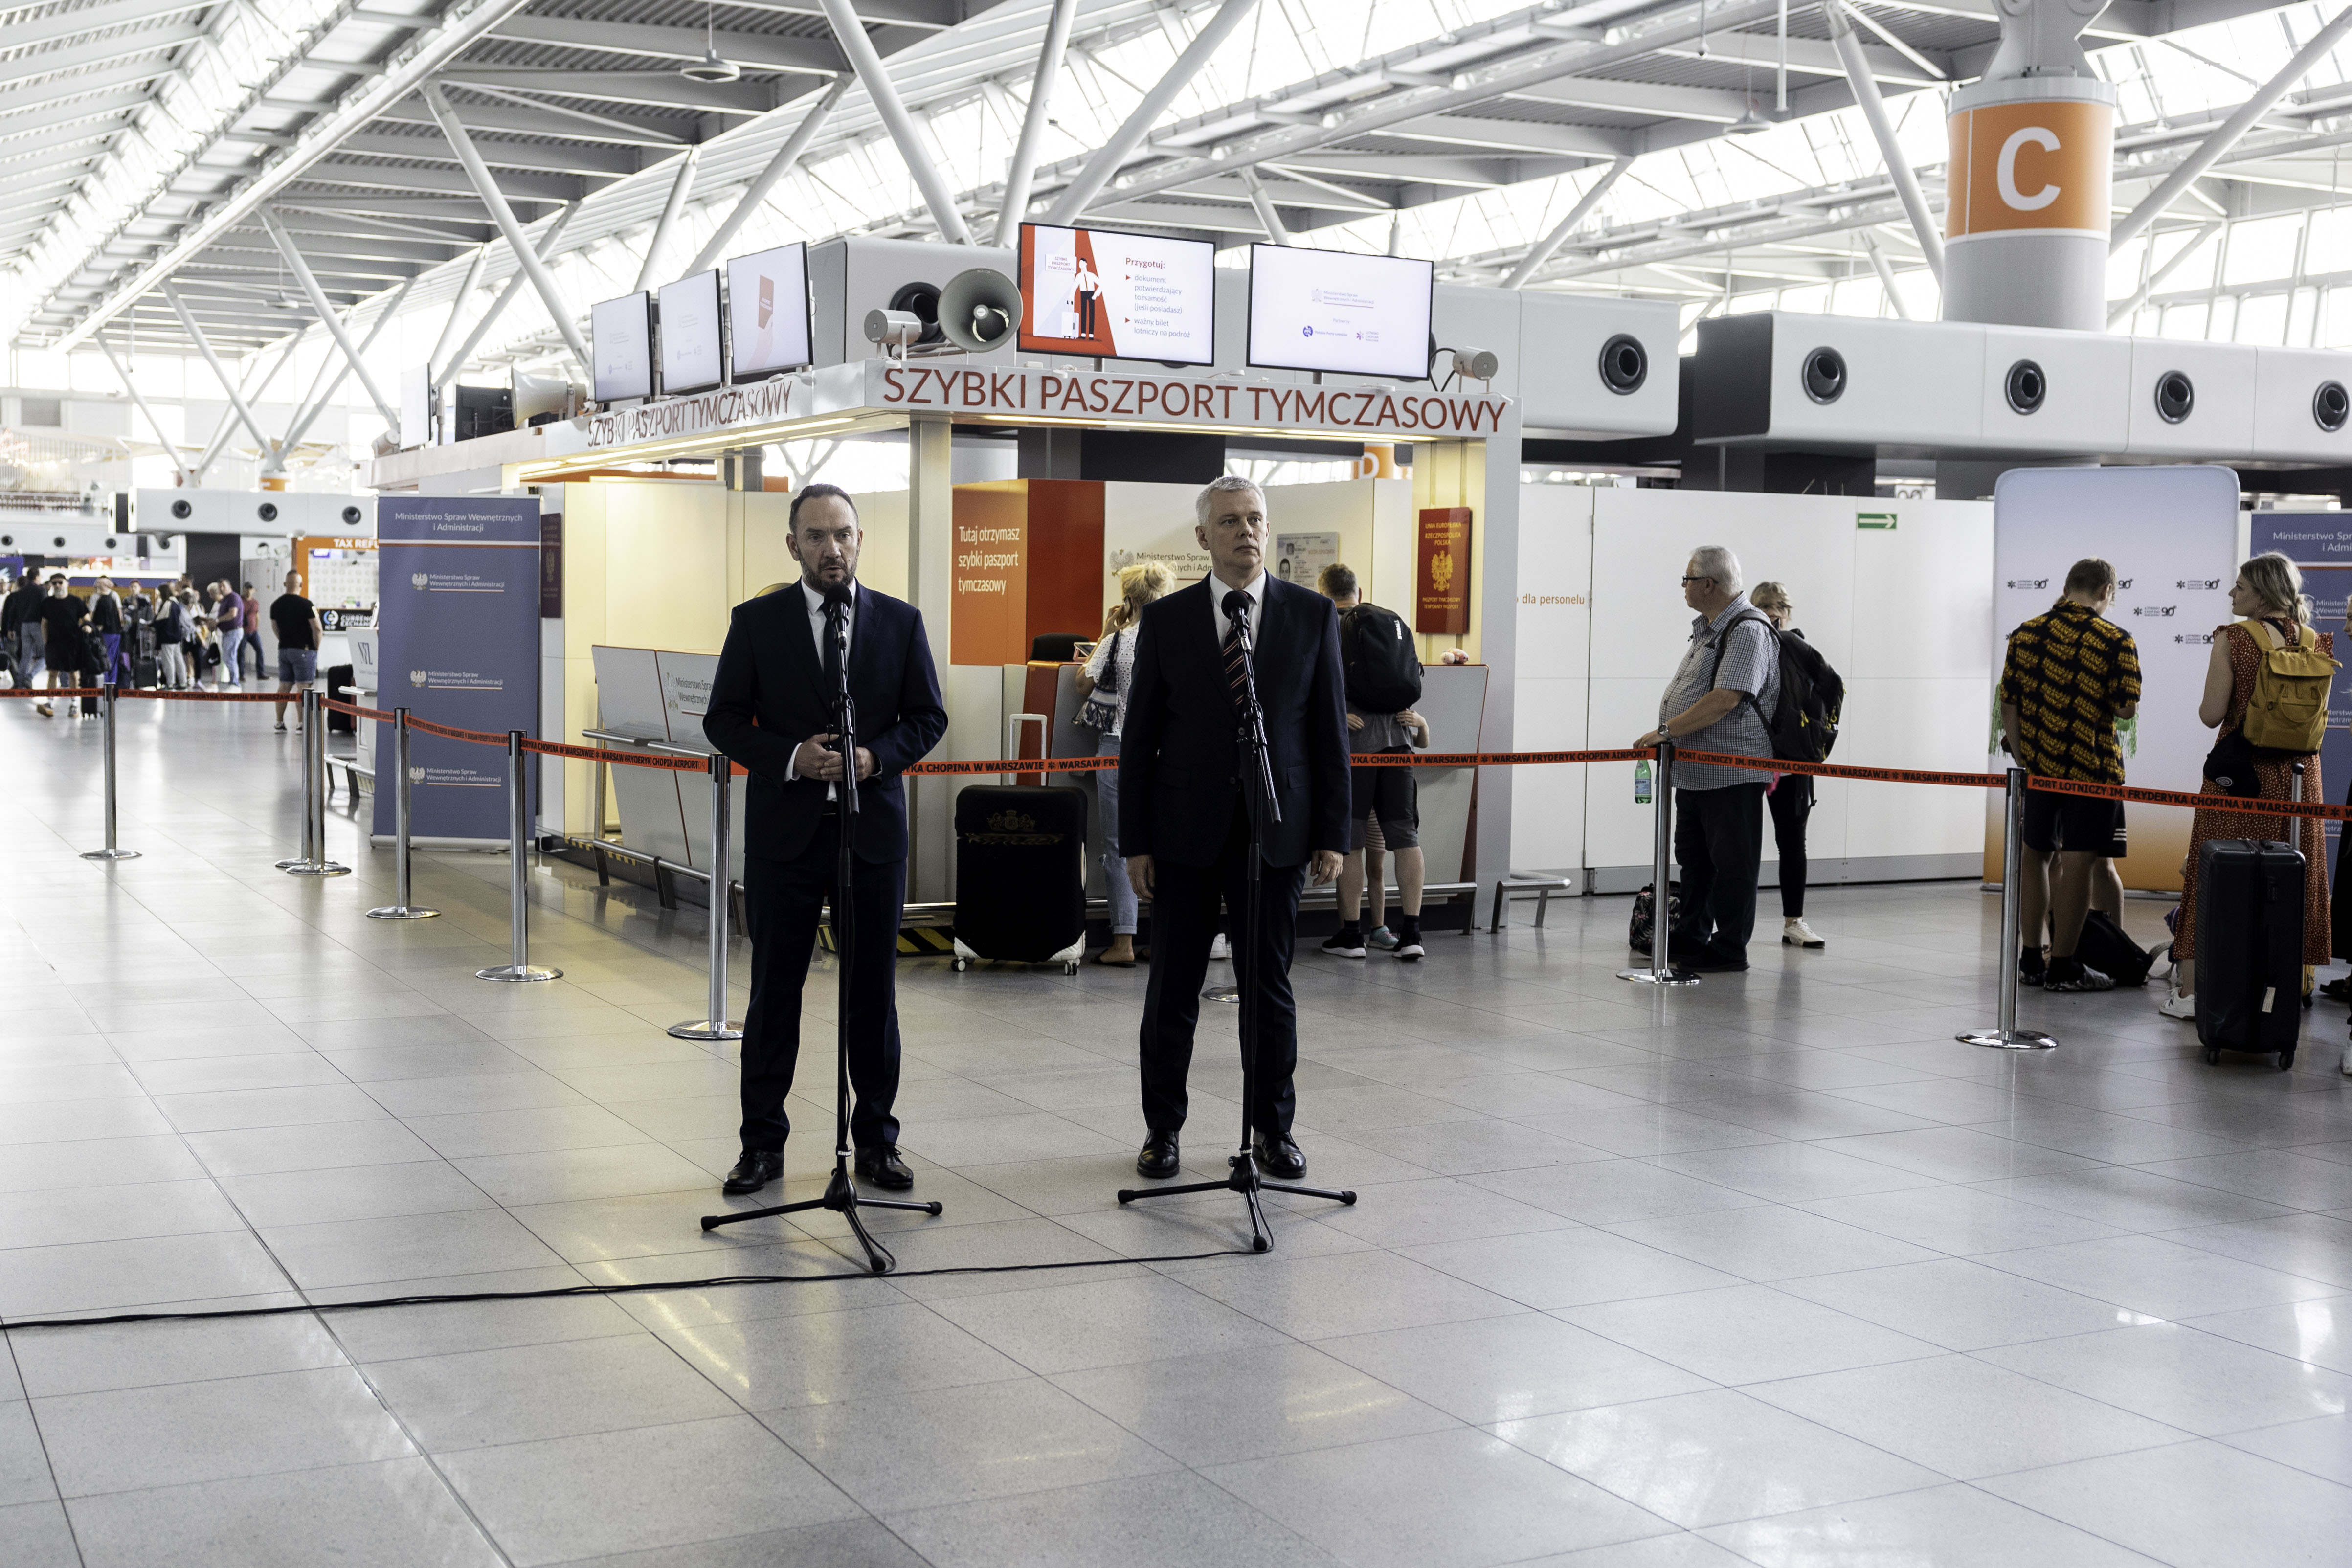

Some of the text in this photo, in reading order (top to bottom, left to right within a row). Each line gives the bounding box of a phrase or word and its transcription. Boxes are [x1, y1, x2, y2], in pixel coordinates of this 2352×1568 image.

[1997, 126, 2061, 211] C
[1126, 257, 1165, 269] Przygotuj:
[1135, 274, 1166, 284] dokument
[1135, 285, 1182, 295] potwierdzający
[1135, 294, 1167, 303] tożsamość
[1134, 303, 1183, 314] (jeśli posiadasz)
[1134, 318, 1154, 326] ważny
[1134, 327, 1159, 336] lotniczy
[883, 368, 1506, 432] SZYBKI PASZPORT TYMCZASOWY
[588, 381, 792, 447] SZYBKI PASZPORT TYMCZASOWY
[1358, 452, 1380, 479] D
[395, 513, 523, 522] Ministerstwo Spraw Wewnętrznych
[437, 523, 484, 533] Administracji
[959, 525, 1020, 545] Tutaj otrzymasz
[2273, 532, 2334, 540] Ministerstwo
[334, 538, 353, 548] TAX
[959, 550, 1019, 570] szybki paszport
[1137, 552, 1209, 561] Ministerstwo Spraw
[958, 577, 1007, 595] tymczasowy
[1522, 593, 1536, 604] dla
[1540, 594, 1585, 606] personelu
[676, 677, 701, 690] Ministerstwo
[678, 691, 708, 706] Wewnętrznych
[538, 742, 559, 753] CHOPINA
[565, 747, 594, 758] WARSZAWIE
[601, 751, 624, 762] WARSAW
[625, 754, 652, 765] FRYDERYK
[652, 758, 673, 768] CHOPIN
[674, 759, 699, 769] AIRPORT
[1371, 756, 1411, 764] CHOPINA
[1413, 756, 1423, 764] W
[1424, 755, 1478, 763] WARSZAWIE
[1492, 754, 1532, 762] WARSAW
[1532, 753, 1576, 762] FRYDERYK
[1577, 752, 1610, 761] CHOPIN
[1611, 750, 1648, 759] AIRPORT
[926, 763, 971, 773] CHOPINA
[973, 763, 983, 772] W
[986, 761, 1044, 771] WARSZAWIE
[1059, 759, 1101, 769] WARSAW
[1678, 751, 1697, 760] PORT
[1698, 753, 1733, 764] LOTNICZY
[1748, 759, 1791, 771] FRYDERYKA
[1792, 763, 1828, 774] CHOPINA
[1830, 767, 1838, 775] W
[1839, 767, 1889, 779] WARSZAWIE
[1902, 772, 1941, 782] WARSAW
[1943, 775, 1989, 785] FRYDERYK
[2032, 778, 2057, 788] PORT
[2059, 781, 2107, 796] LOTNICZY
[2109, 787, 2125, 798] IM.
[2128, 789, 2189, 804] FRYDERYKA
[2191, 795, 2240, 809] CHOPINA
[2242, 800, 2254, 809] W
[2256, 801, 2326, 817] WARSZAWIE
